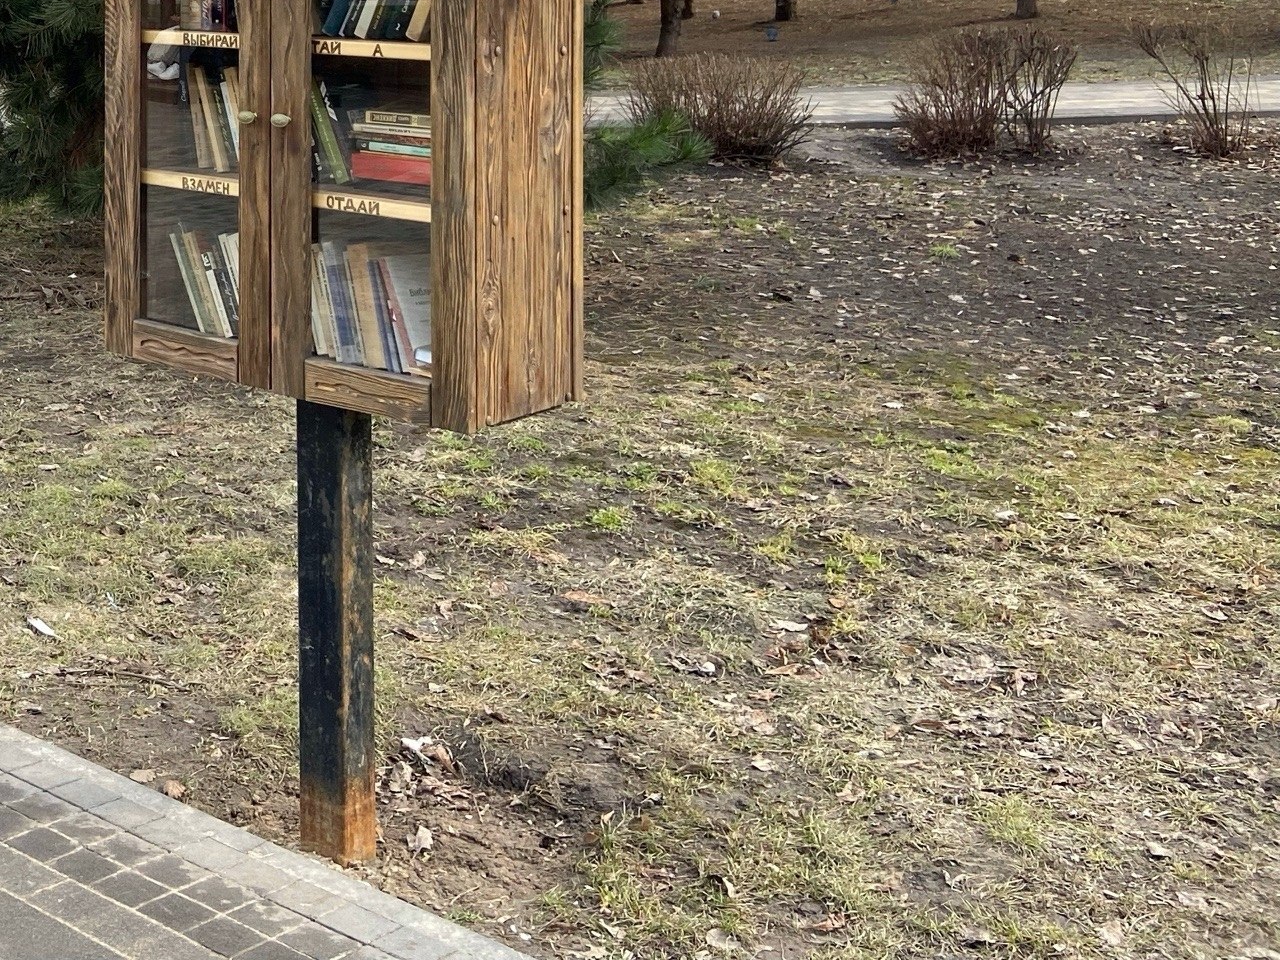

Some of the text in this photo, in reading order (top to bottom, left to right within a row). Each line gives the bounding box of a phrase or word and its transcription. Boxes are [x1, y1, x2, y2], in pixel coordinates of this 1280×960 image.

[182, 32, 384, 57] ВЫБИРАЙ ТАЙ А
[181, 176, 380, 216] ВЗАМЕН ОТДАЙ
